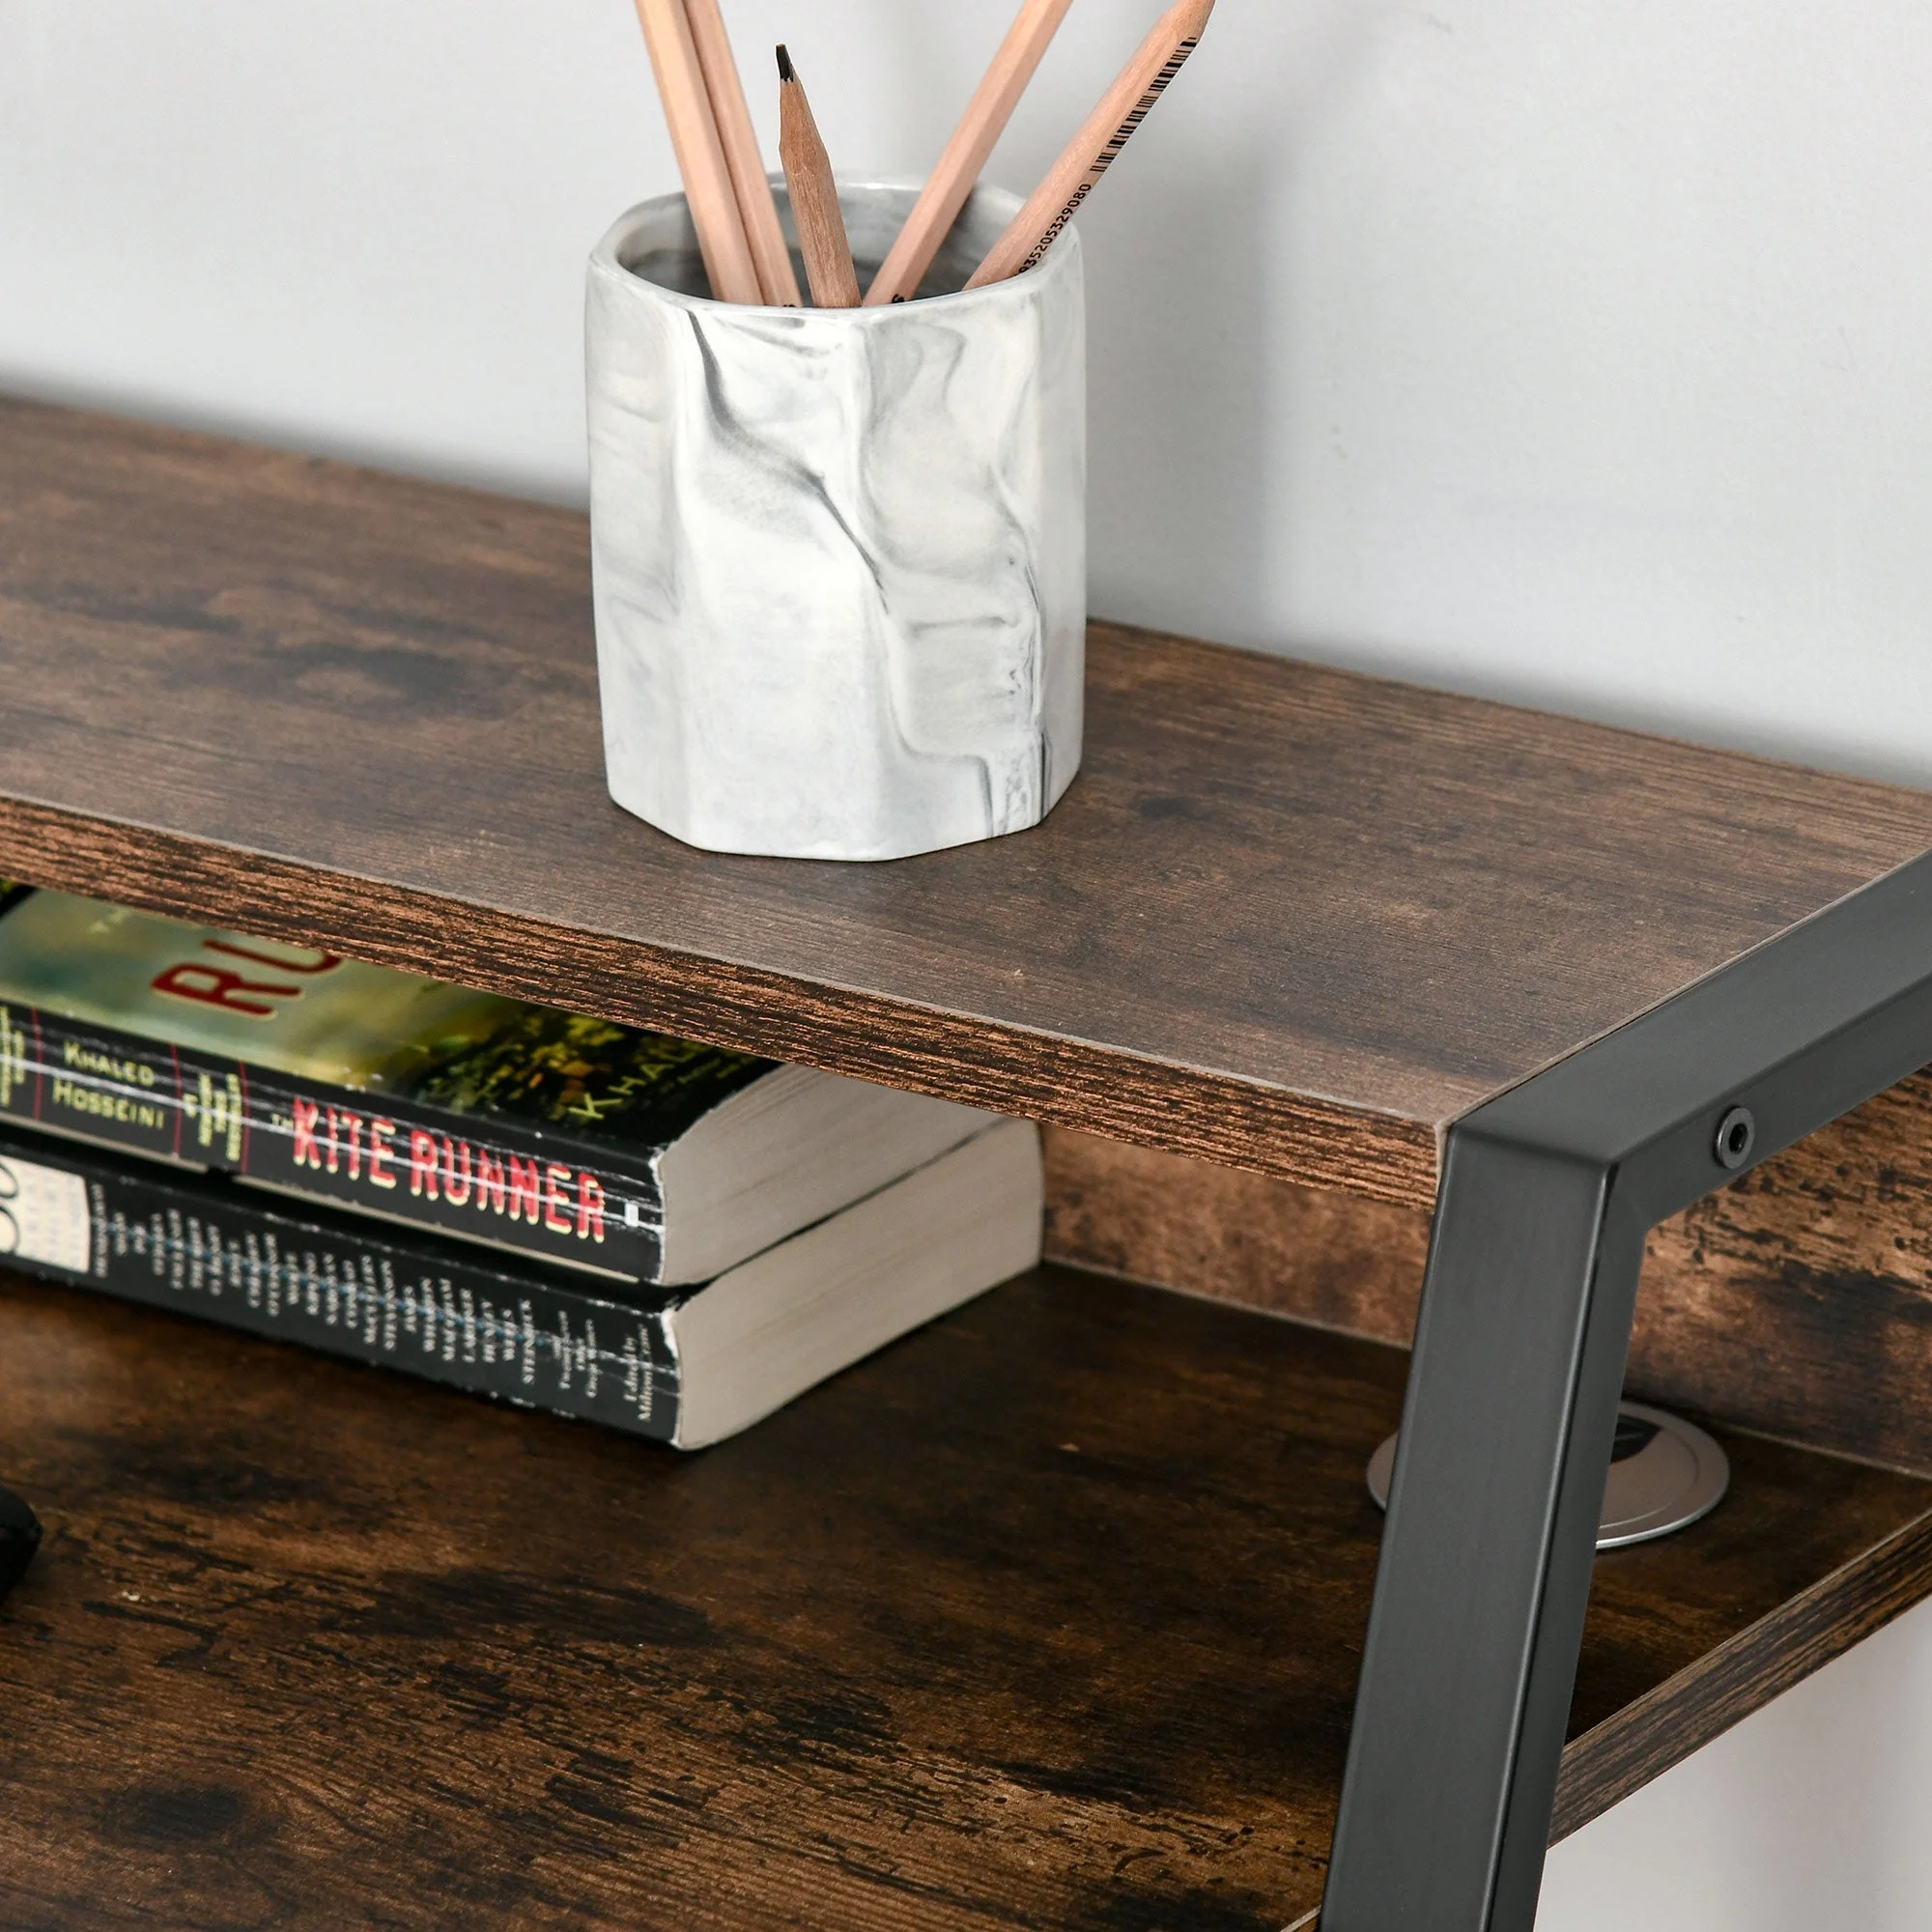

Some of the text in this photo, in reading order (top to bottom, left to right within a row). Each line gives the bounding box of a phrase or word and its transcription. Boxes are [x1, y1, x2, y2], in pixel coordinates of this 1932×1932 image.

[63, 1038, 155, 1087] KHALED
[52, 1076, 165, 1129] HOSSEINI
[293, 1096, 397, 1189] KITE
[410, 1128, 606, 1244] RUNNER
